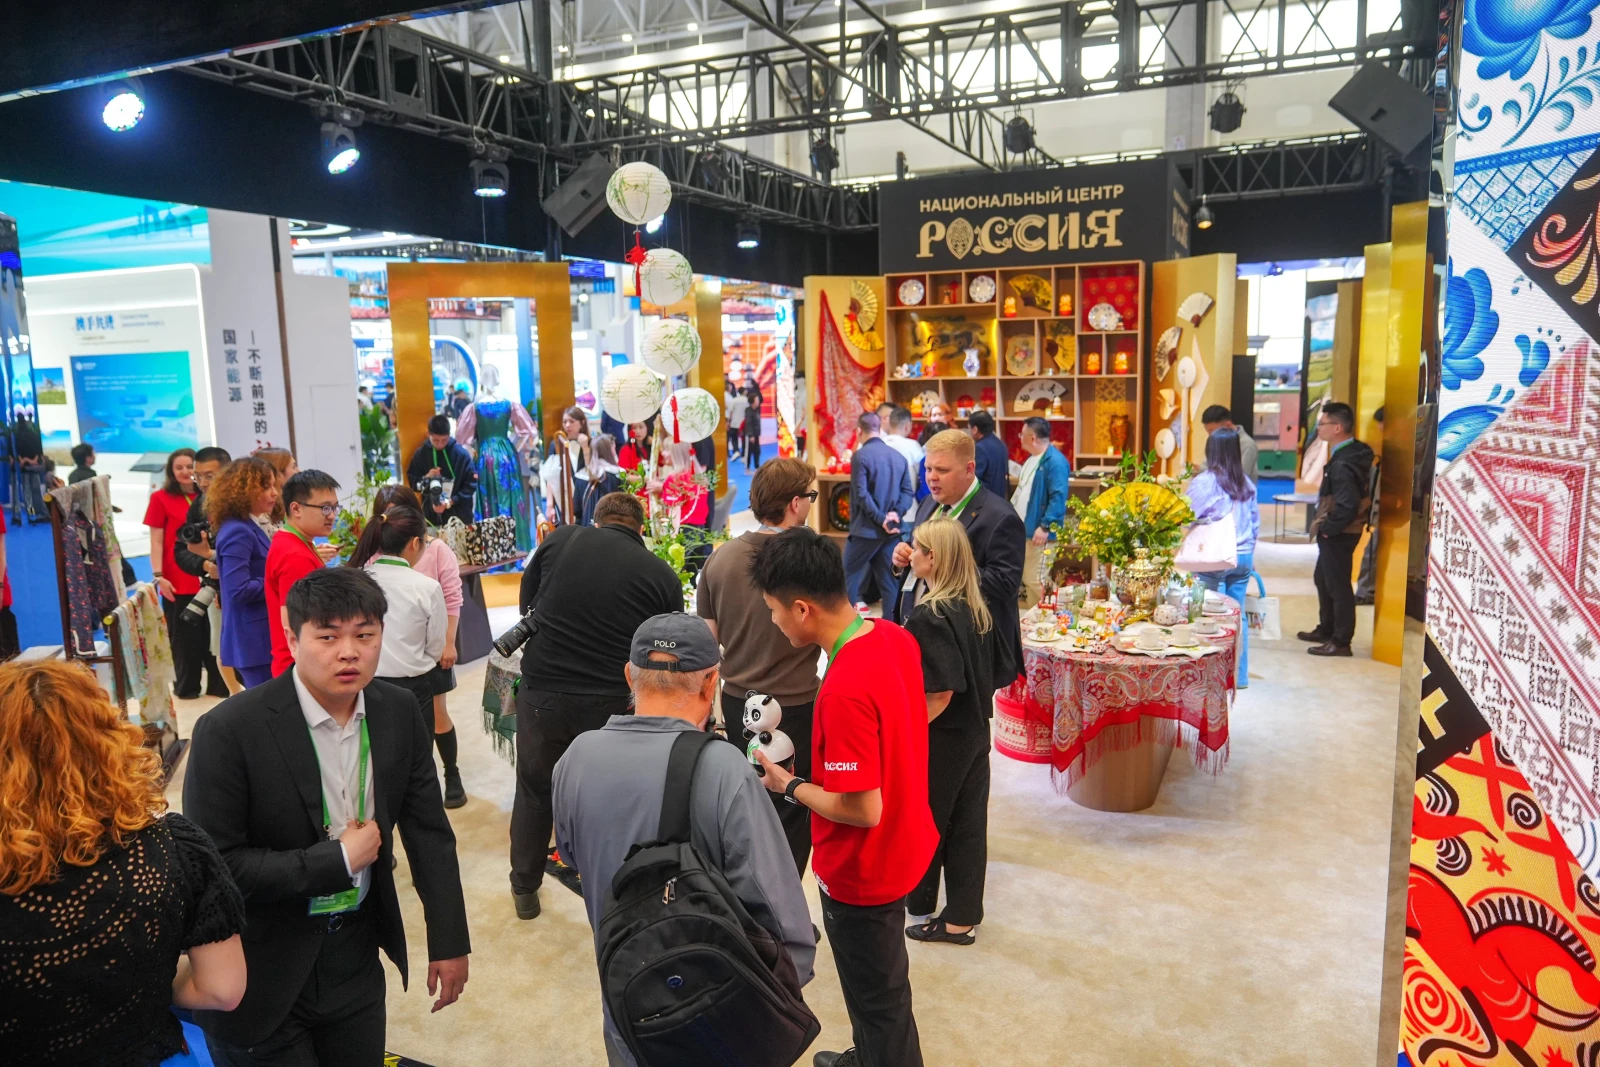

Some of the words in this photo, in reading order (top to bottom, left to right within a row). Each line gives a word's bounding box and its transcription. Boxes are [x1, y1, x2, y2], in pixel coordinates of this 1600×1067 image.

[919, 186, 1063, 212] НАЦИОНАЛЬНЫЙ
[1067, 184, 1124, 204] ЦЕНТР
[916, 208, 1123, 260] РОССИЯ
[223, 329, 242, 402] 国家能源
[654, 639, 676, 648] POLO
